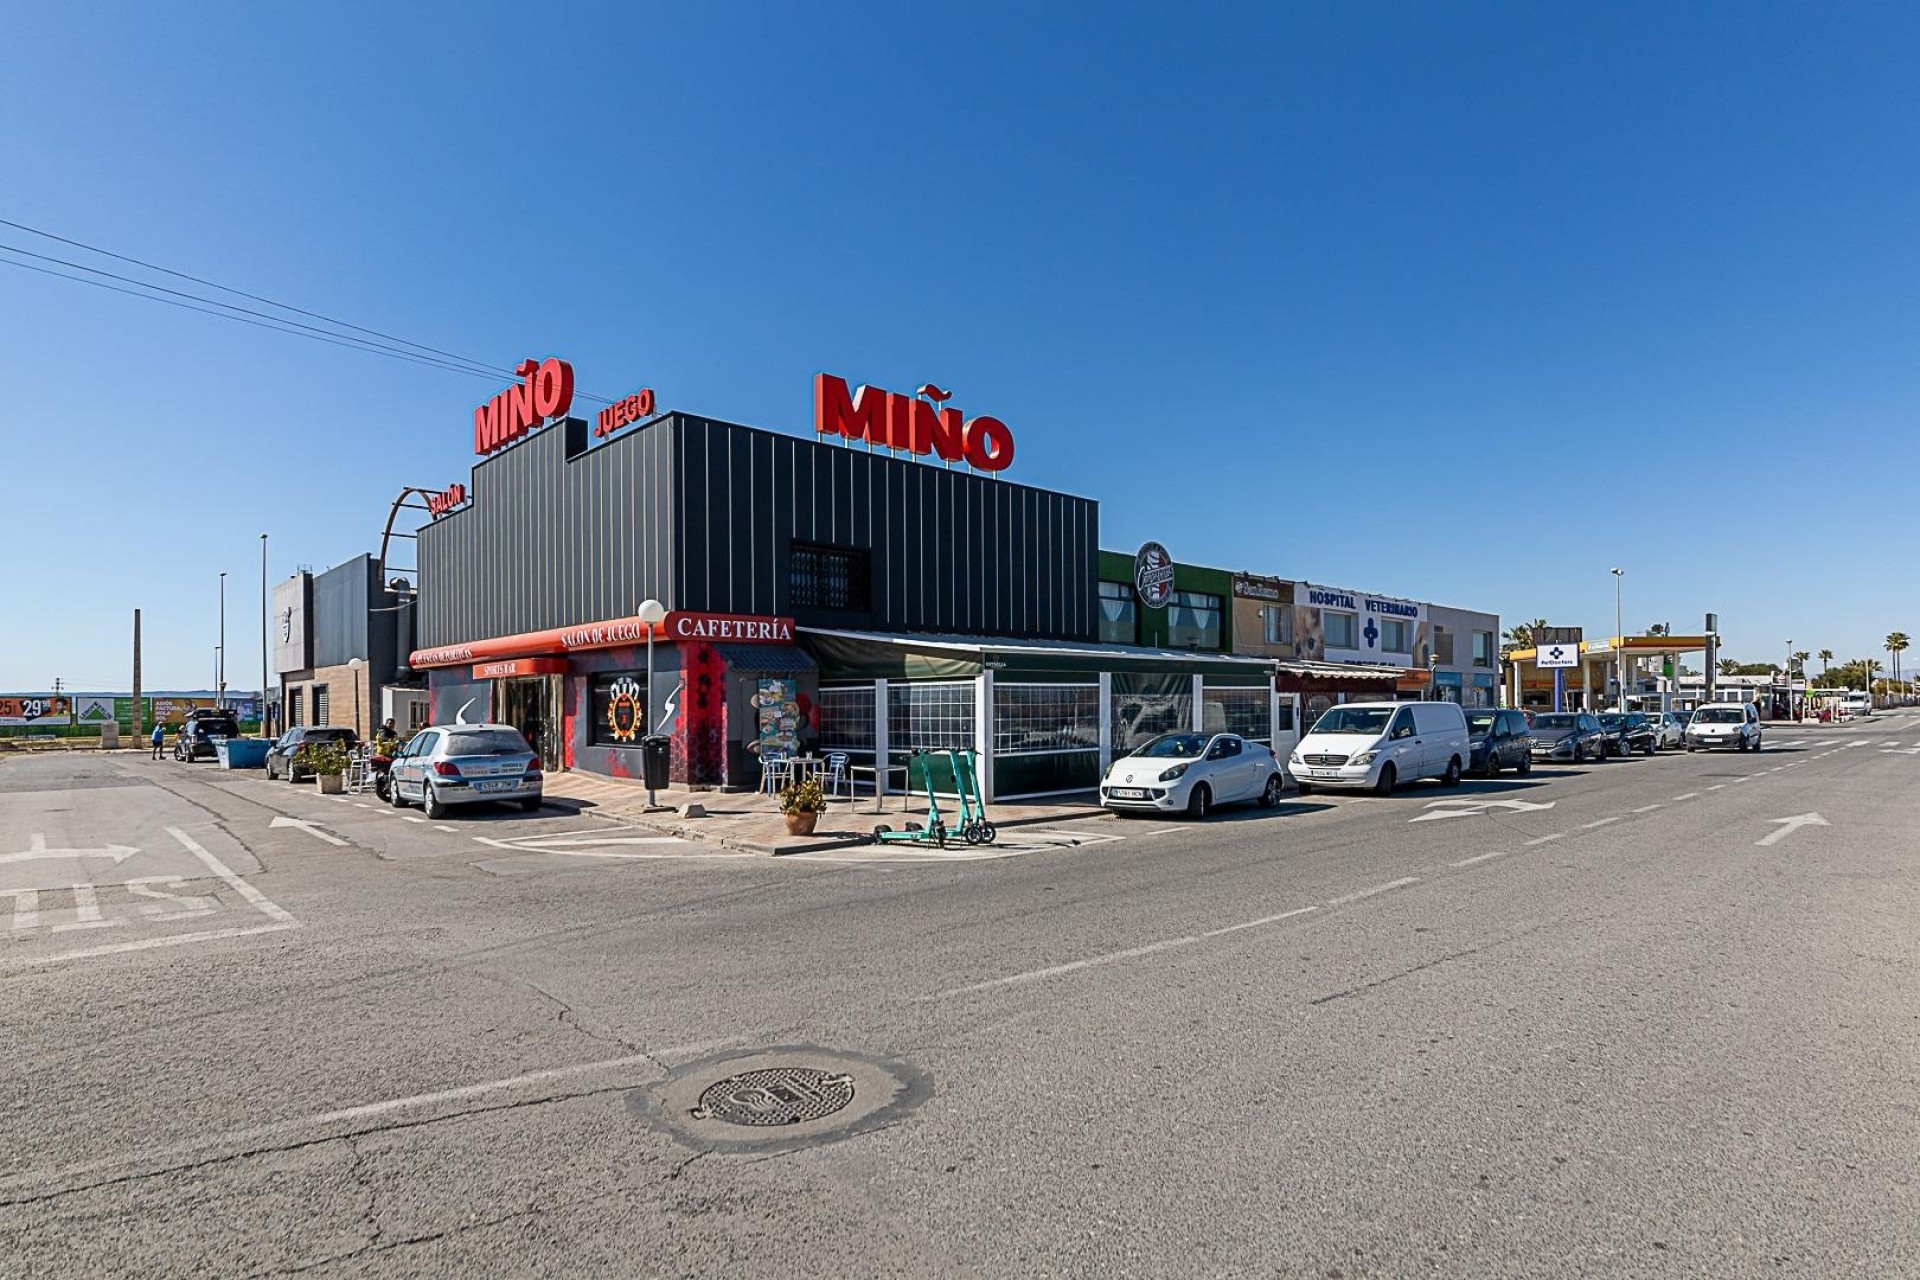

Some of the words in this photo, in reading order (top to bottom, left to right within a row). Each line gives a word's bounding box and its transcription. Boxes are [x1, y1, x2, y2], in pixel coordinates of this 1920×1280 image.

[474, 357, 574, 455] MIÑO
[593, 388, 655, 438] JUEGO
[814, 372, 1015, 471] MIÑO
[1309, 588, 1357, 610] HOSPITAL
[1364, 599, 1418, 618] VETERINARIO
[606, 622, 641, 642] JUEGO
[677, 617, 792, 640] CAFETERÍA
